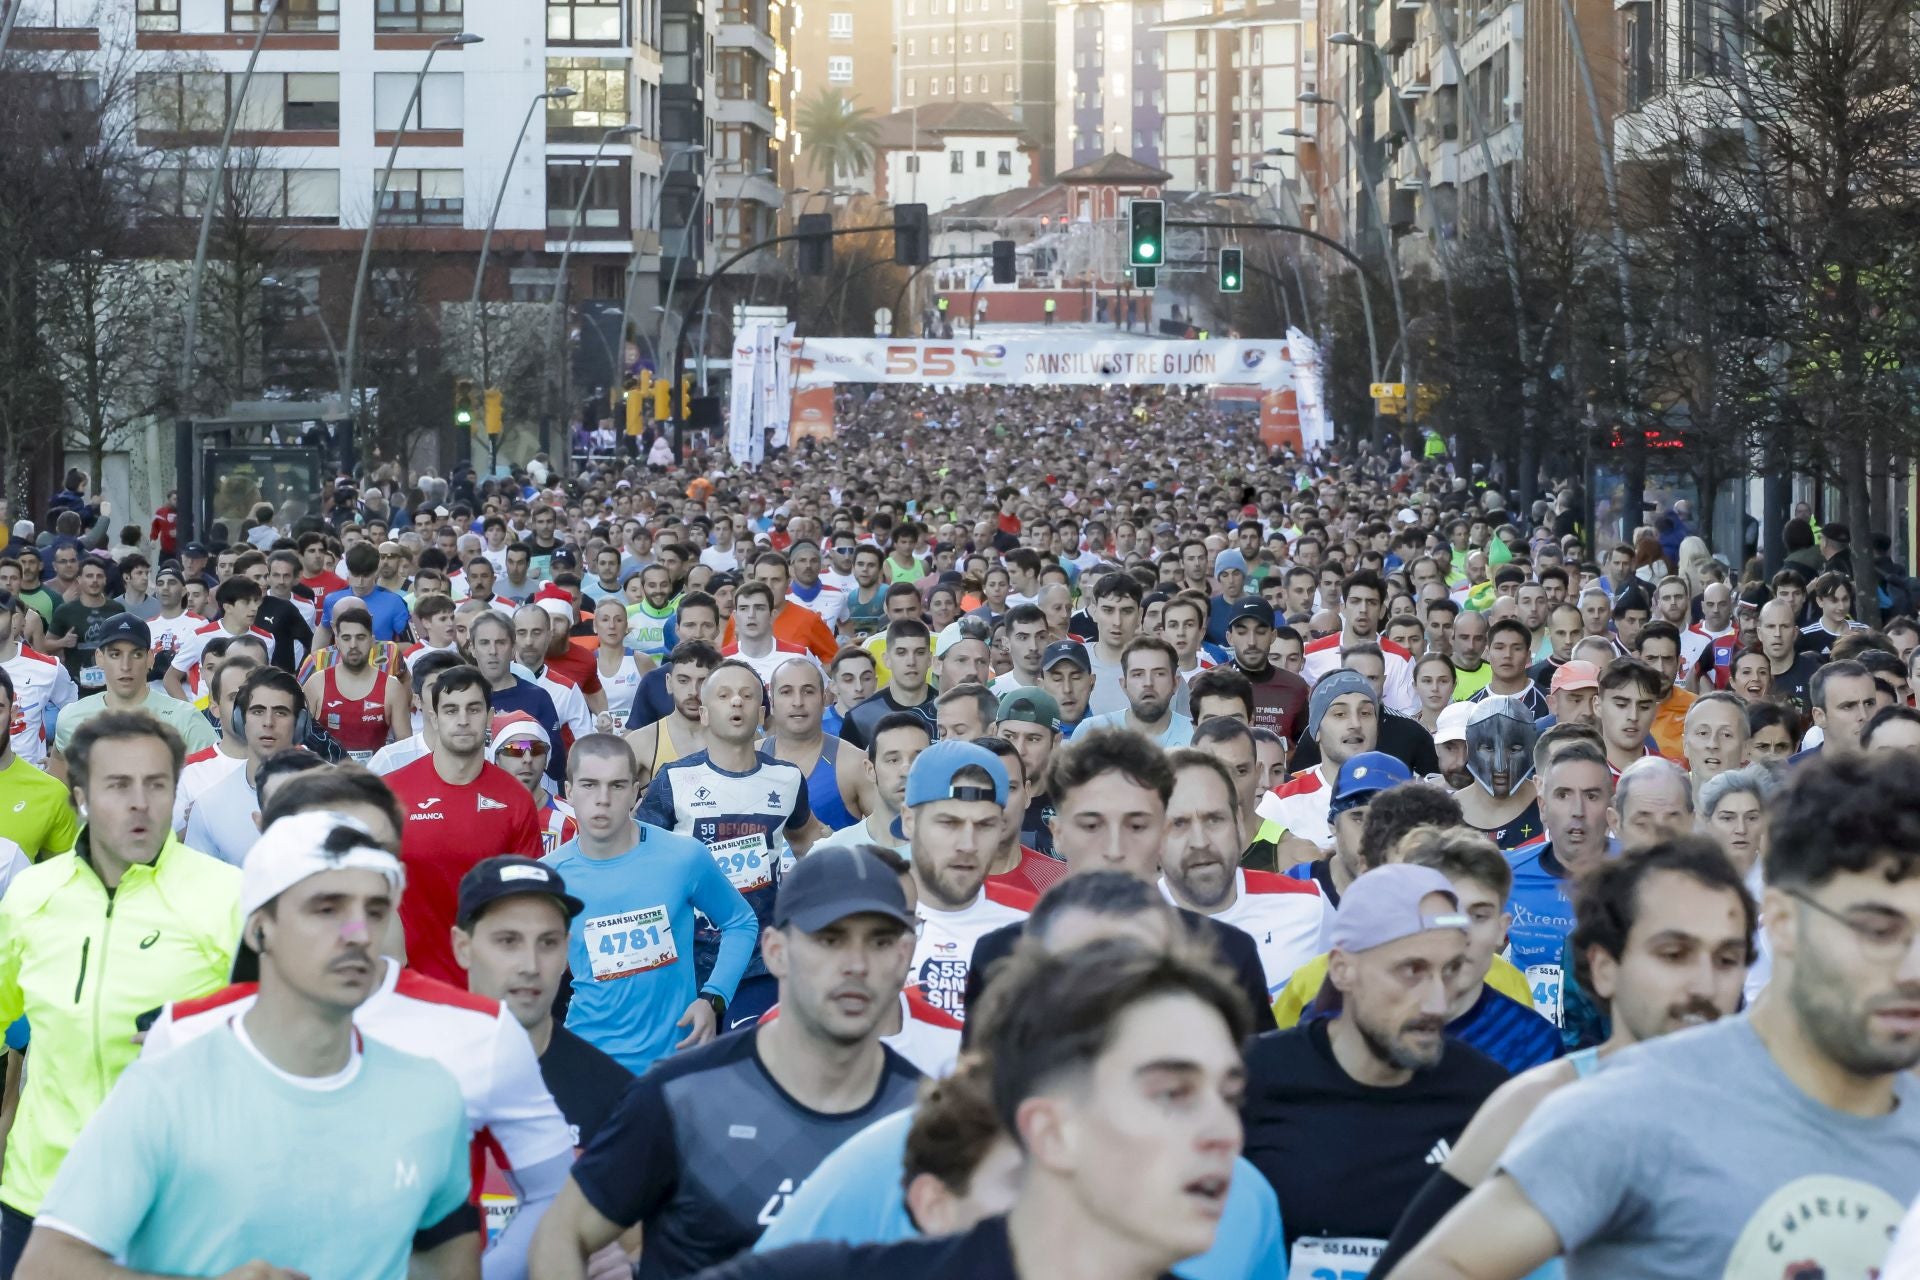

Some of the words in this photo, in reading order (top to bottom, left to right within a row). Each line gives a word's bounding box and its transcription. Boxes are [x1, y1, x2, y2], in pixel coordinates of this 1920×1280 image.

[885, 346, 956, 376] 55
[1025, 352, 1158, 374] SANSILVESTRE
[1163, 350, 1217, 374] GIJÓN
[690, 800, 717, 808] FORTUNA
[713, 843, 727, 852] SAN
[727, 836, 761, 849] SILVESTRE
[717, 850, 762, 876] 296
[597, 920, 607, 928] 55
[607, 917, 623, 927] SAN
[623, 909, 663, 924] SILVESTRE
[598, 925, 661, 956] 4781
[940, 962, 967, 978] 55
[1549, 968, 1560, 976] SA
[926, 971, 966, 993] SAN
[927, 990, 965, 1009] SIL
[1533, 982, 1559, 1005] 49
[1342, 1244, 1369, 1257] SAN
